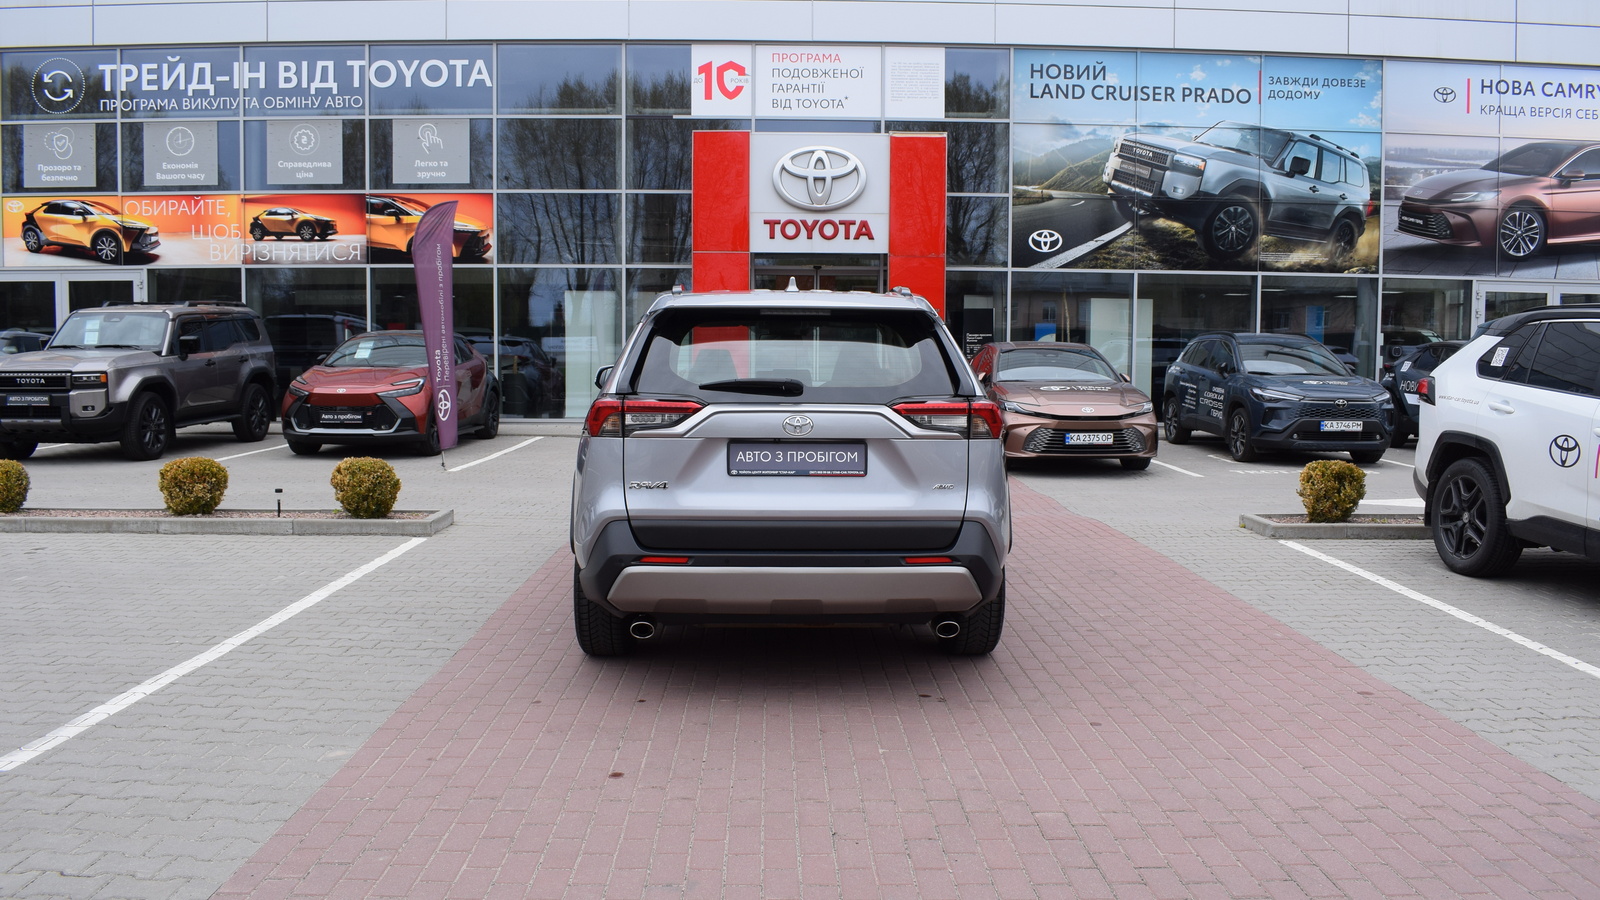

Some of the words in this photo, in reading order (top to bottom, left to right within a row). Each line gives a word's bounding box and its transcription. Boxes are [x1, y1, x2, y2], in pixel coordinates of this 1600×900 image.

[772, 53, 841, 63] ПРОГРАМА
[98, 56, 266, 96] ТРЕЙД-ІН
[278, 60, 338, 94] ВІД
[347, 59, 493, 88] TOYOTA
[772, 66, 864, 80] ПОДОВЖЕНОЇ
[1030, 61, 1106, 80] НОВИЙ
[772, 82, 826, 93] ГАРАНТІЇ
[1268, 76, 1318, 88] ЗАВЖДИ
[1322, 78, 1366, 89] ДОВЕЗЕ
[1480, 79, 1536, 96] НОВА
[1030, 83, 1085, 99] LAND
[1092, 85, 1175, 102] CRUISER
[1182, 88, 1252, 104] PRADO
[1268, 89, 1321, 101] ДОДОМУ
[100, 97, 178, 112] ПРОГРАМА
[183, 96, 239, 110] ВИКУПУ
[243, 96, 260, 109] ТА
[263, 96, 321, 109] ОБМІНУ
[324, 96, 363, 108] АВТО
[772, 98, 792, 110] ВІД
[1480, 104, 1526, 118] КРАЩА
[1530, 106, 1572, 118] ВЕРСІЯ
[1132, 148, 1152, 157] TOYOTA
[38, 164, 72, 174] Прозоро
[278, 160, 332, 170] Справедлива
[41, 173, 78, 181] безпечно
[186, 172, 205, 180] часу
[296, 170, 314, 179] ціна
[124, 196, 231, 217] ОБИРАЙТЕ,
[192, 224, 242, 242] ЩОБ
[764, 218, 874, 240] TOYOTA
[210, 243, 361, 262] ВИРІЗНЯТИСЯ
[442, 336, 450, 381] Перевірені
[1204, 390, 1224, 400] COROLLA
[1200, 398, 1223, 409] CROSS
[736, 450, 772, 462] АВТО
[775, 451, 783, 462] З
[788, 451, 858, 462] ПРОБІГОМ
[629, 481, 668, 490] RAV4
